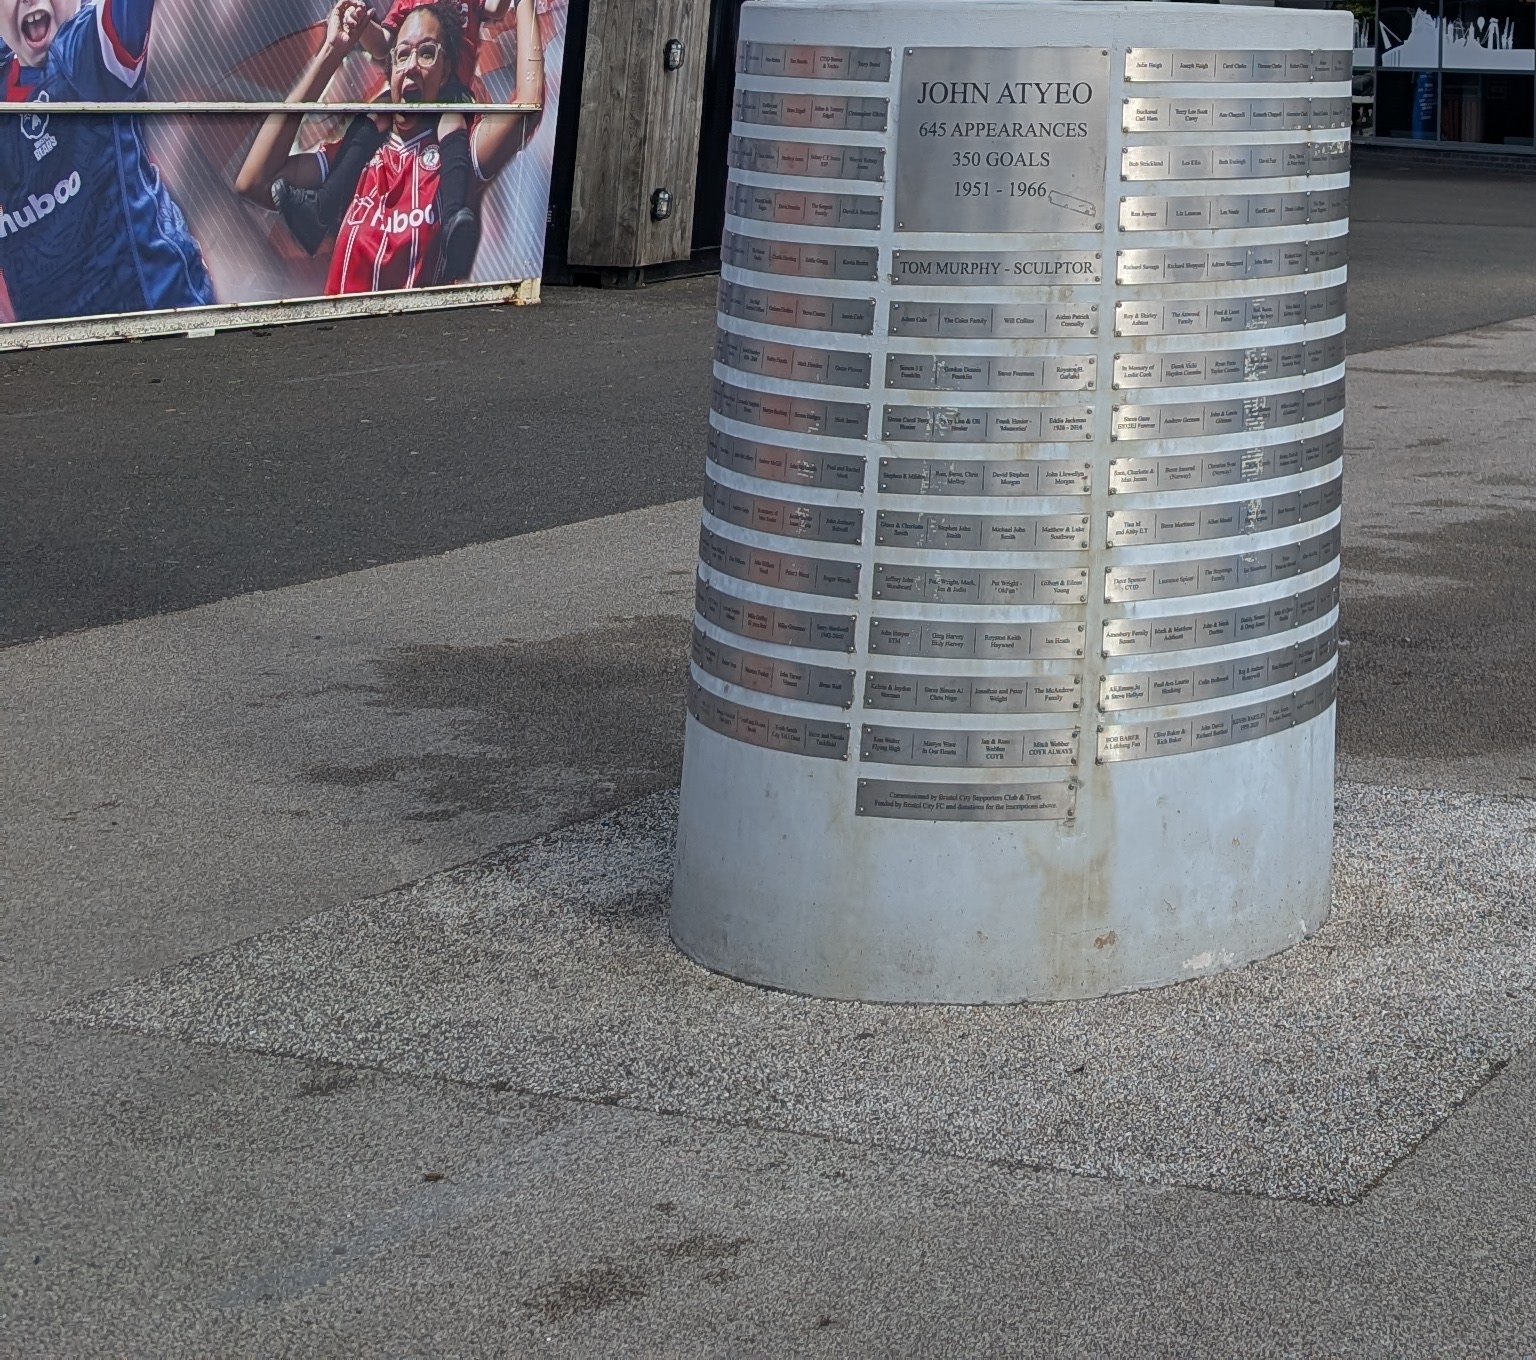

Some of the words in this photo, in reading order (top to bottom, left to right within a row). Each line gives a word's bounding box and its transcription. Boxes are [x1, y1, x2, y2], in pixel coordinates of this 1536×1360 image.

[917, 82, 990, 104] JOHN
[996, 81, 1093, 104] ATYEO
[919, 122, 946, 137] 645
[951, 122, 1088, 138] APPEARANCES
[34, 136, 58, 161] BEARS
[952, 152, 980, 167] 350
[986, 152, 1050, 167] GOALS
[954, 182, 989, 197] 1951
[1009, 182, 1047, 197] 1966
[900, 262, 935, 275] TOM
[936, 261, 1001, 275] MURPHY
[1013, 261, 1094, 275] SCULPTOR
[970, 317, 987, 325] Family
[1128, 364, 1148, 372] Memory
[1009, 471, 1029, 479] Stephen
[1055, 478, 1074, 486] Morgan
[959, 794, 971, 802] City
[972, 794, 1002, 803] Supporters
[895, 801, 902, 809] by
[923, 802, 934, 811] City
[1006, 802, 1038, 811] inscriptions
